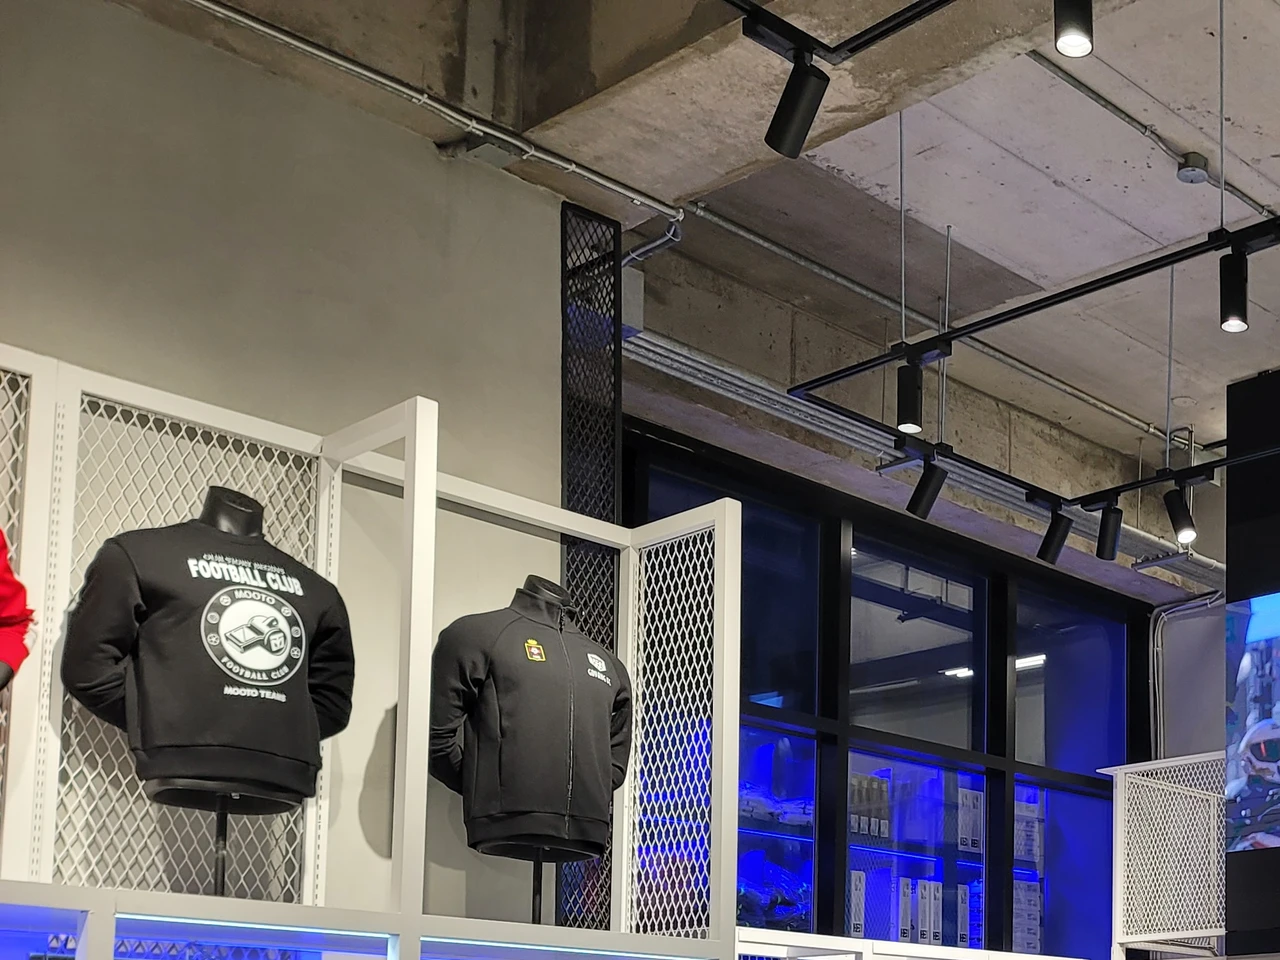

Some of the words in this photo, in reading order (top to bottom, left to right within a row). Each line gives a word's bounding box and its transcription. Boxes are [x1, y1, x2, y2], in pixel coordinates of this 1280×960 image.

[187, 557, 268, 588] FOOTBALL
[266, 571, 305, 596] CLUB
[233, 589, 276, 605] MOOTO
[220, 655, 269, 681] FOOTBALL
[270, 664, 290, 680] CLUB
[223, 685, 259, 697] MOOTO
